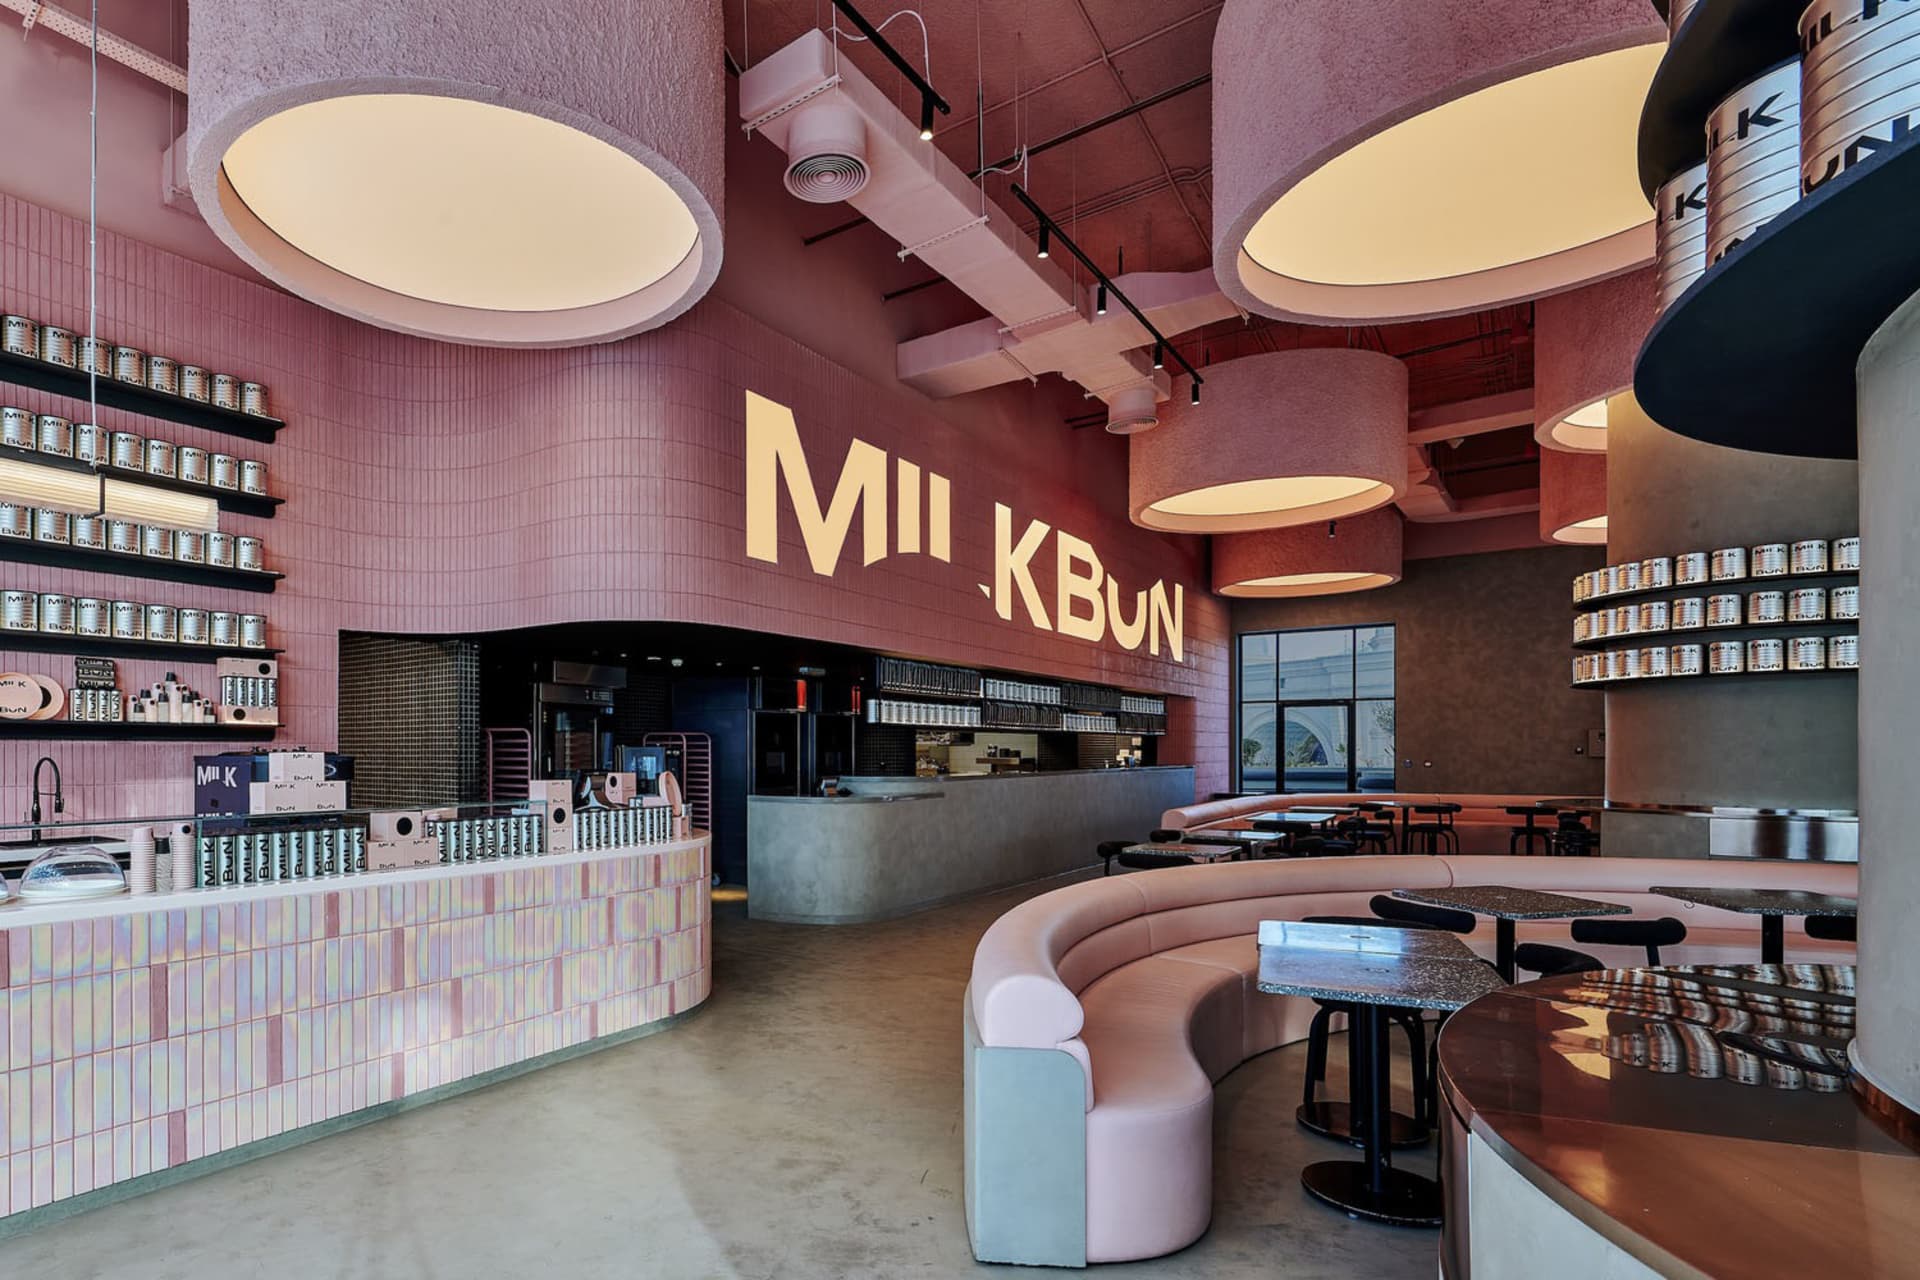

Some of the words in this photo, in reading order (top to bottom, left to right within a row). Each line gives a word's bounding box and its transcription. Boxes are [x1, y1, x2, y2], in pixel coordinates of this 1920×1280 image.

[80, 428, 109, 439] MLK
[6, 437, 34, 449] BUN
[43, 444, 71, 456] BUN
[2, 528, 30, 537] BUN
[43, 532, 70, 542] BUN
[78, 538, 105, 548] BUN
[114, 543, 139, 553] BUN
[1838, 541, 1860, 549] MIL
[1796, 564, 1825, 572] BUN
[1835, 590, 1860, 598] MIL
[79, 603, 108, 611] MILK
[115, 606, 143, 614] MILK
[10, 621, 37, 629] BUN
[49, 622, 74, 631] BUN
[79, 626, 107, 635] BUN
[117, 629, 143, 637] BUN
[151, 631, 176, 639] BUN
[1834, 639, 1860, 647] MIL
[75, 690, 84, 720] MILK
[88, 691, 97, 719] BUN
[100, 690, 109, 720] MILK
[112, 690, 120, 720] BUN
[197, 765, 238, 788] MILK
[477, 823, 485, 857] BUN
[488, 820, 496, 858] MILK
[512, 820, 520, 855] MILK
[356, 831, 365, 869] BUN
[440, 826, 448, 863] MILK
[259, 838, 269, 879] BUN
[279, 837, 288, 879] MILK
[325, 834, 334, 872] BUN
[205, 842, 215, 886] MILK
[223, 841, 233, 882] BUN
[244, 839, 252, 882] MILK
